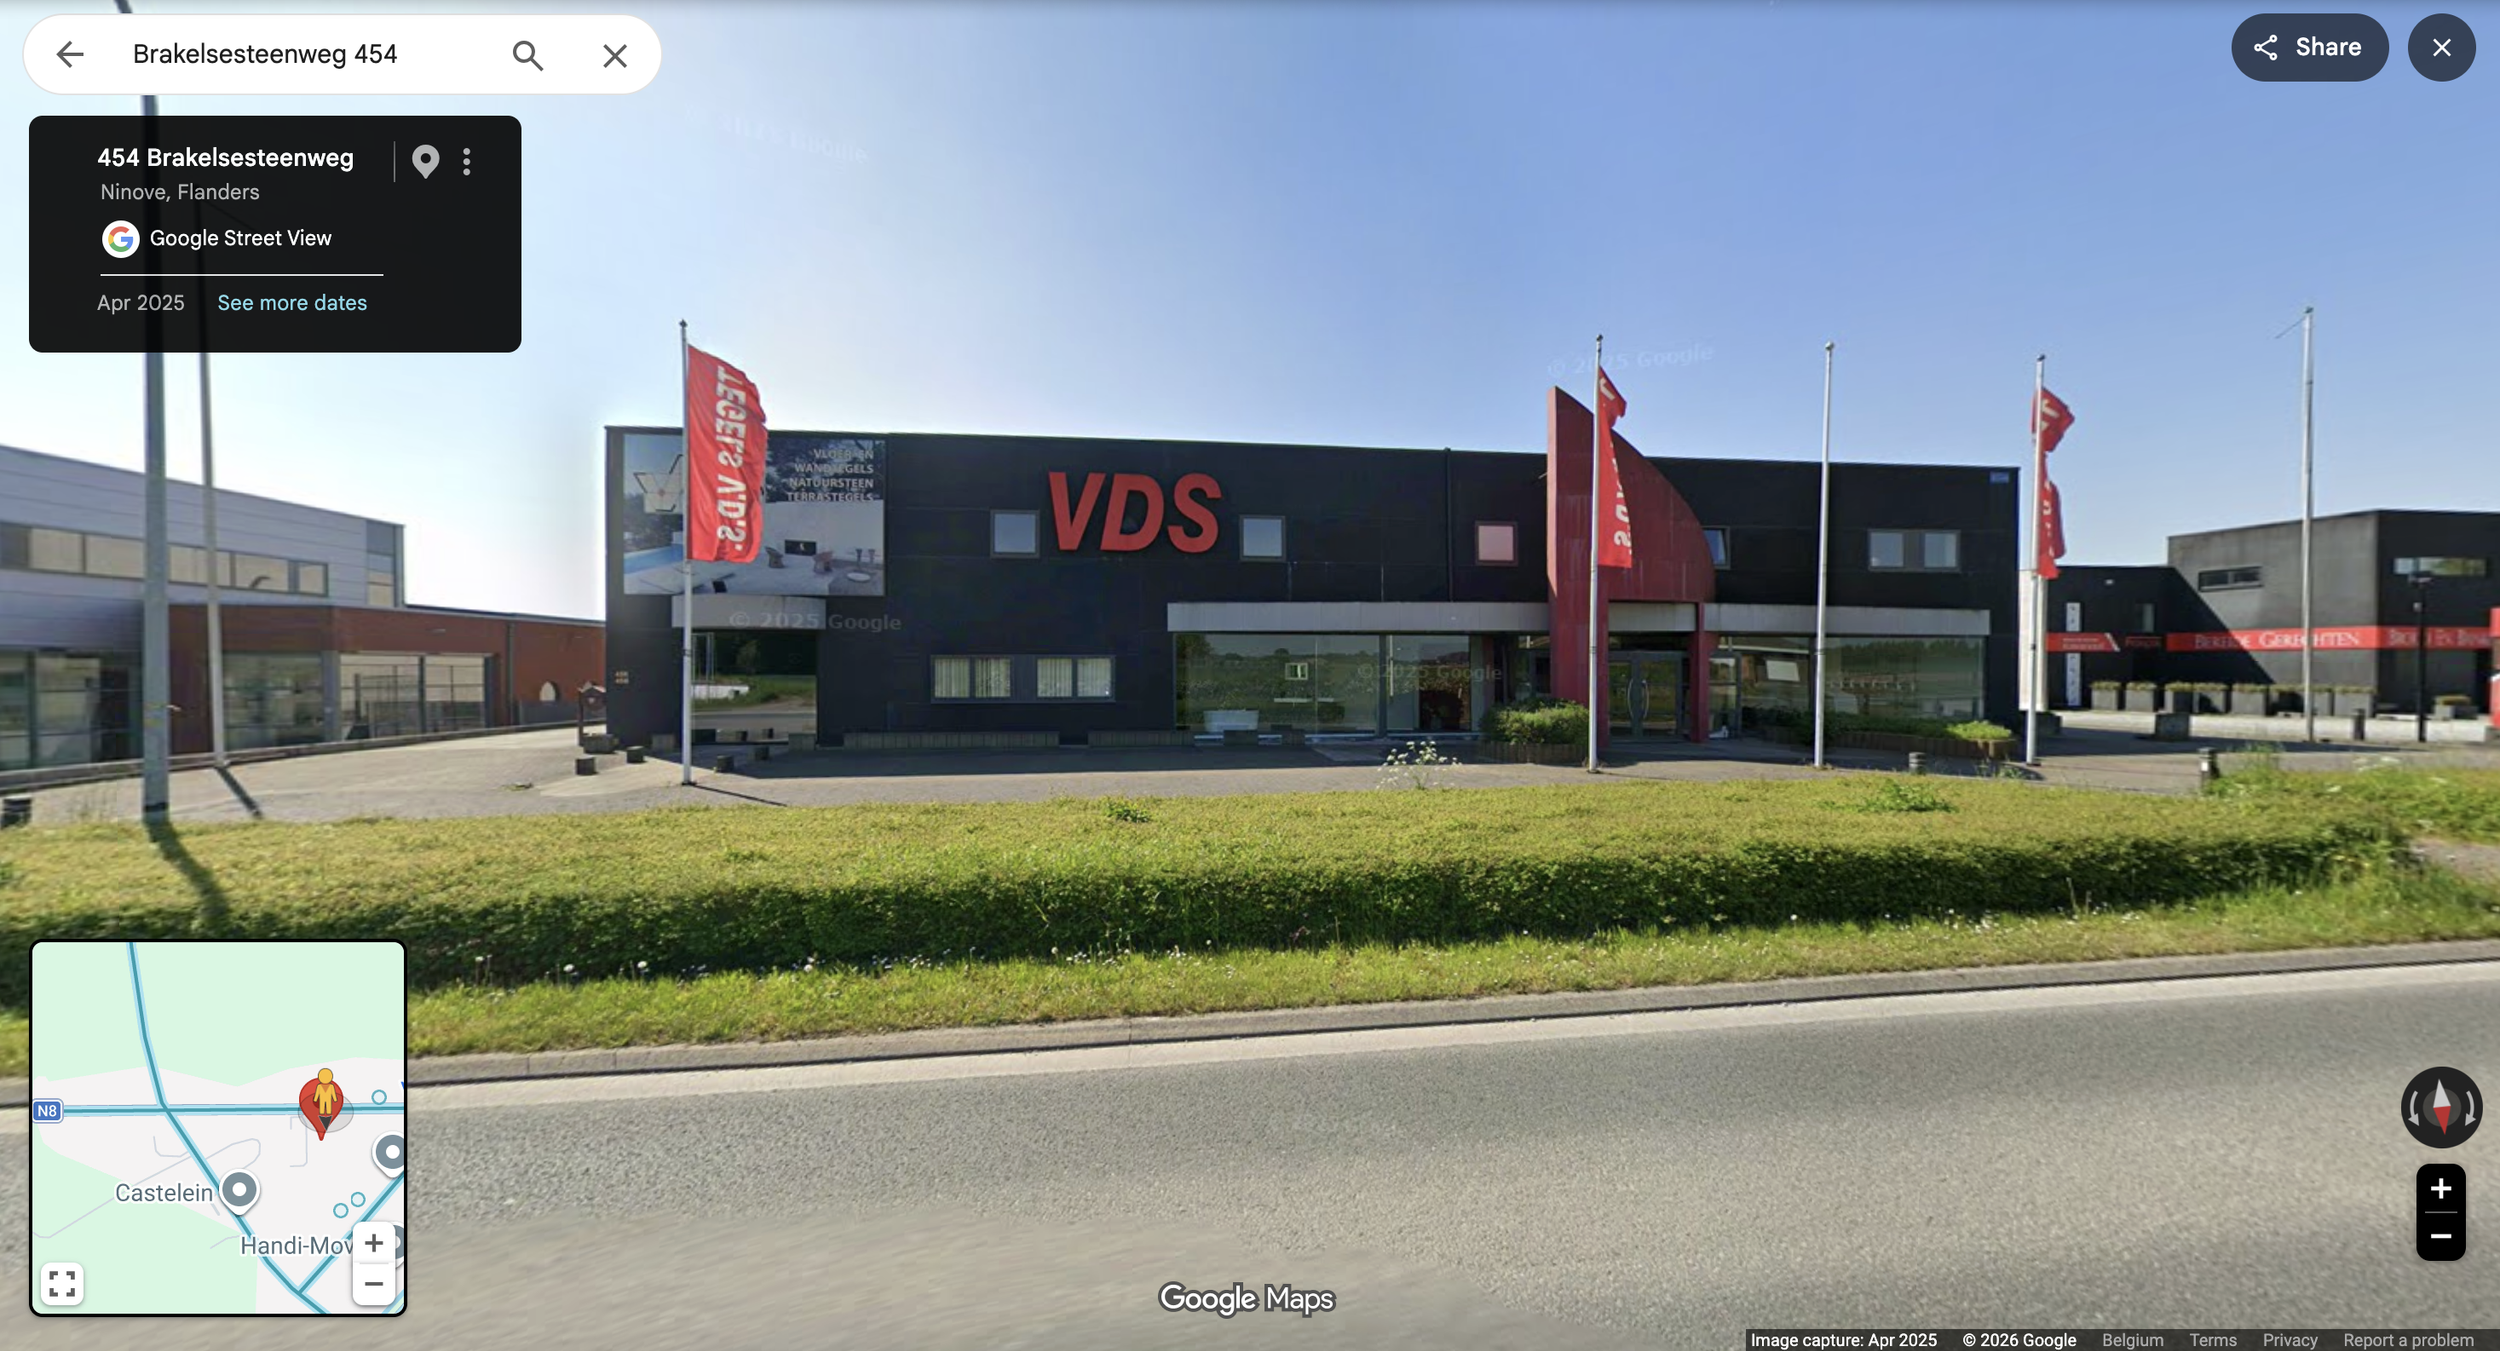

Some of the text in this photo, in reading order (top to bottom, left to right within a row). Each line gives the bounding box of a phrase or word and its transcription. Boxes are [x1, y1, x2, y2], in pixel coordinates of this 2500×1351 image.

[789, 478, 874, 488] NATUURSTEEN
[787, 492, 874, 502] TERRASTEGELS
[1049, 472, 1222, 554] VDS
